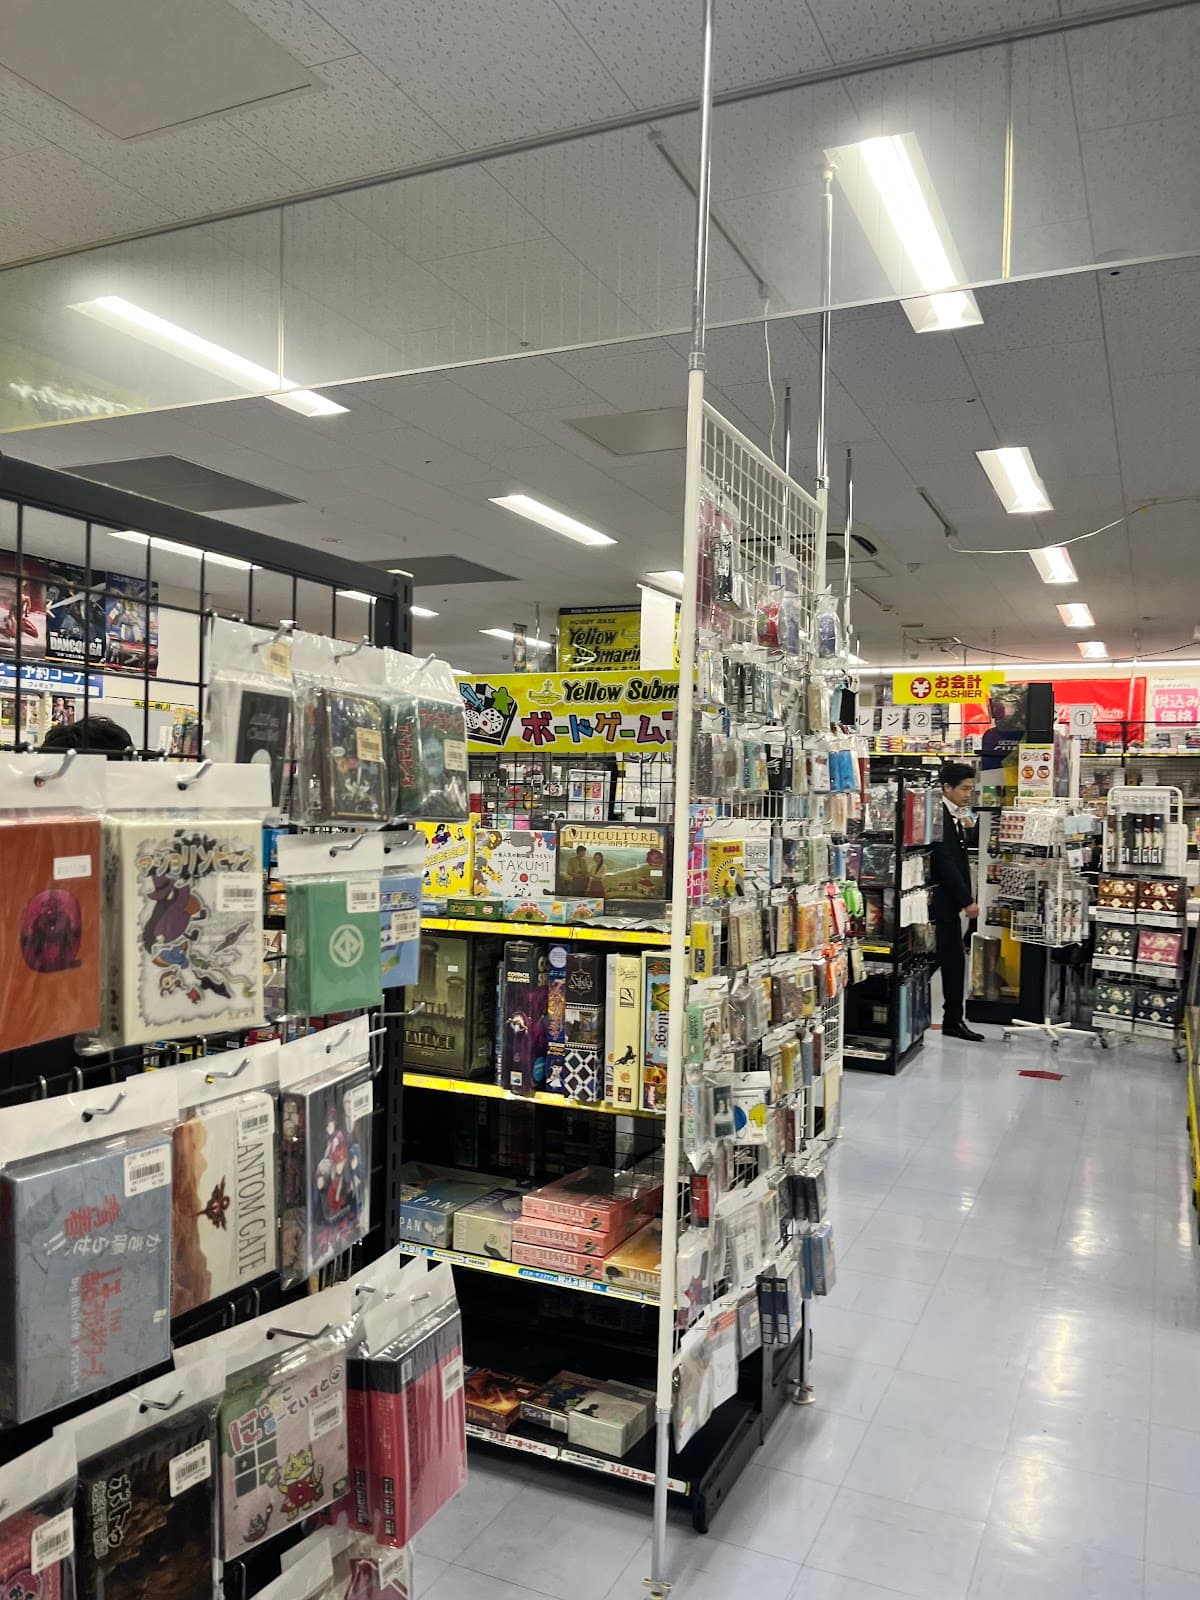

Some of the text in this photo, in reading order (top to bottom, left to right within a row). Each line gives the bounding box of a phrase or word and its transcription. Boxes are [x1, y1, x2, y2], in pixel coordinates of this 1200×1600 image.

[935, 675, 982, 689] お会計
[563, 681, 622, 701] Yellow
[935, 690, 982, 698] CASHIER
[1154, 694, 1200, 708] 税込み
[1161, 709, 1193, 722] 価格
[568, 826, 658, 843] VITICULTURE
[497, 859, 550, 872] TAKUMI
[511, 872, 538, 883] ZOO
[238, 1219, 266, 1275] GATE
